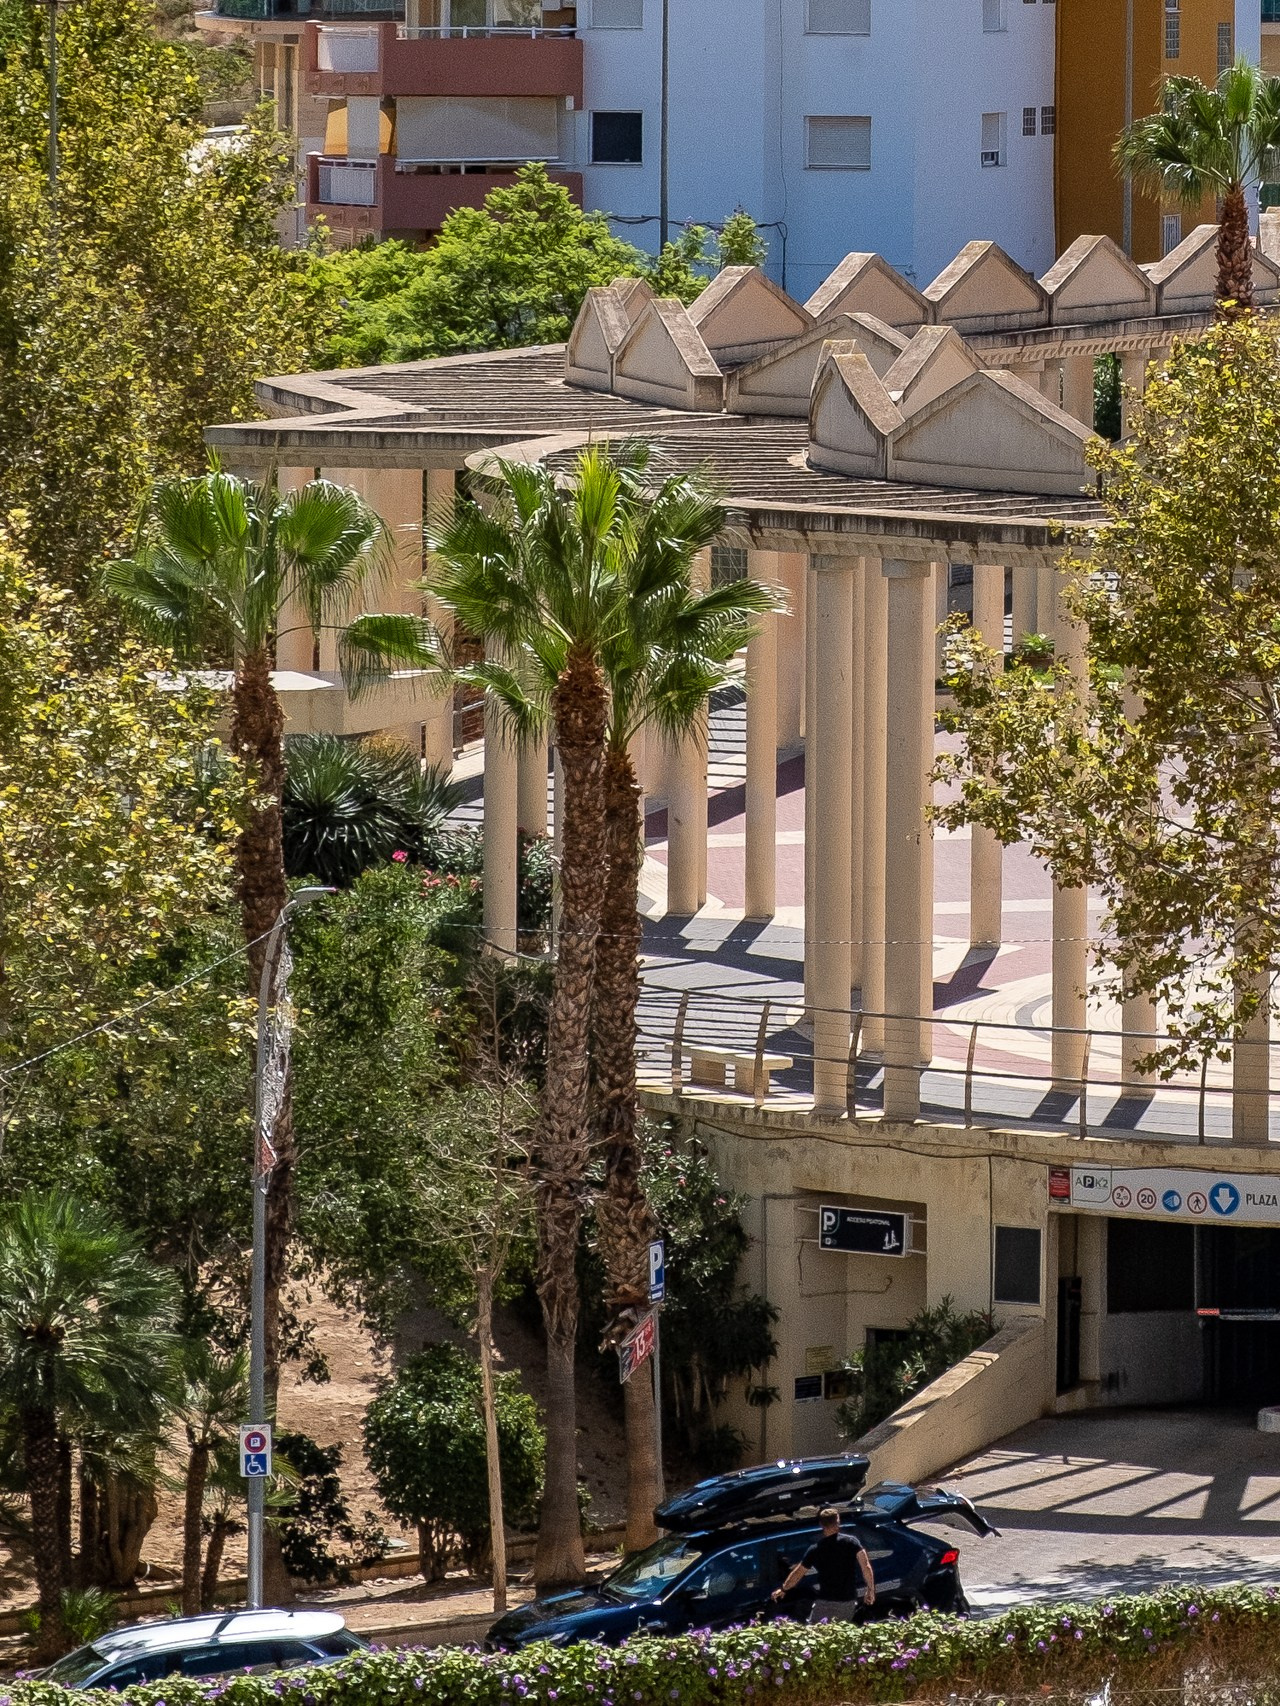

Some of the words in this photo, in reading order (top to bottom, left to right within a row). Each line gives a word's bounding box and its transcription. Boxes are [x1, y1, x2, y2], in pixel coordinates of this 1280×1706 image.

[1140, 1193, 1154, 1205] 20
[1246, 1193, 1278, 1207] PLAZA
[823, 1211, 836, 1231] P
[649, 1244, 663, 1285] P
